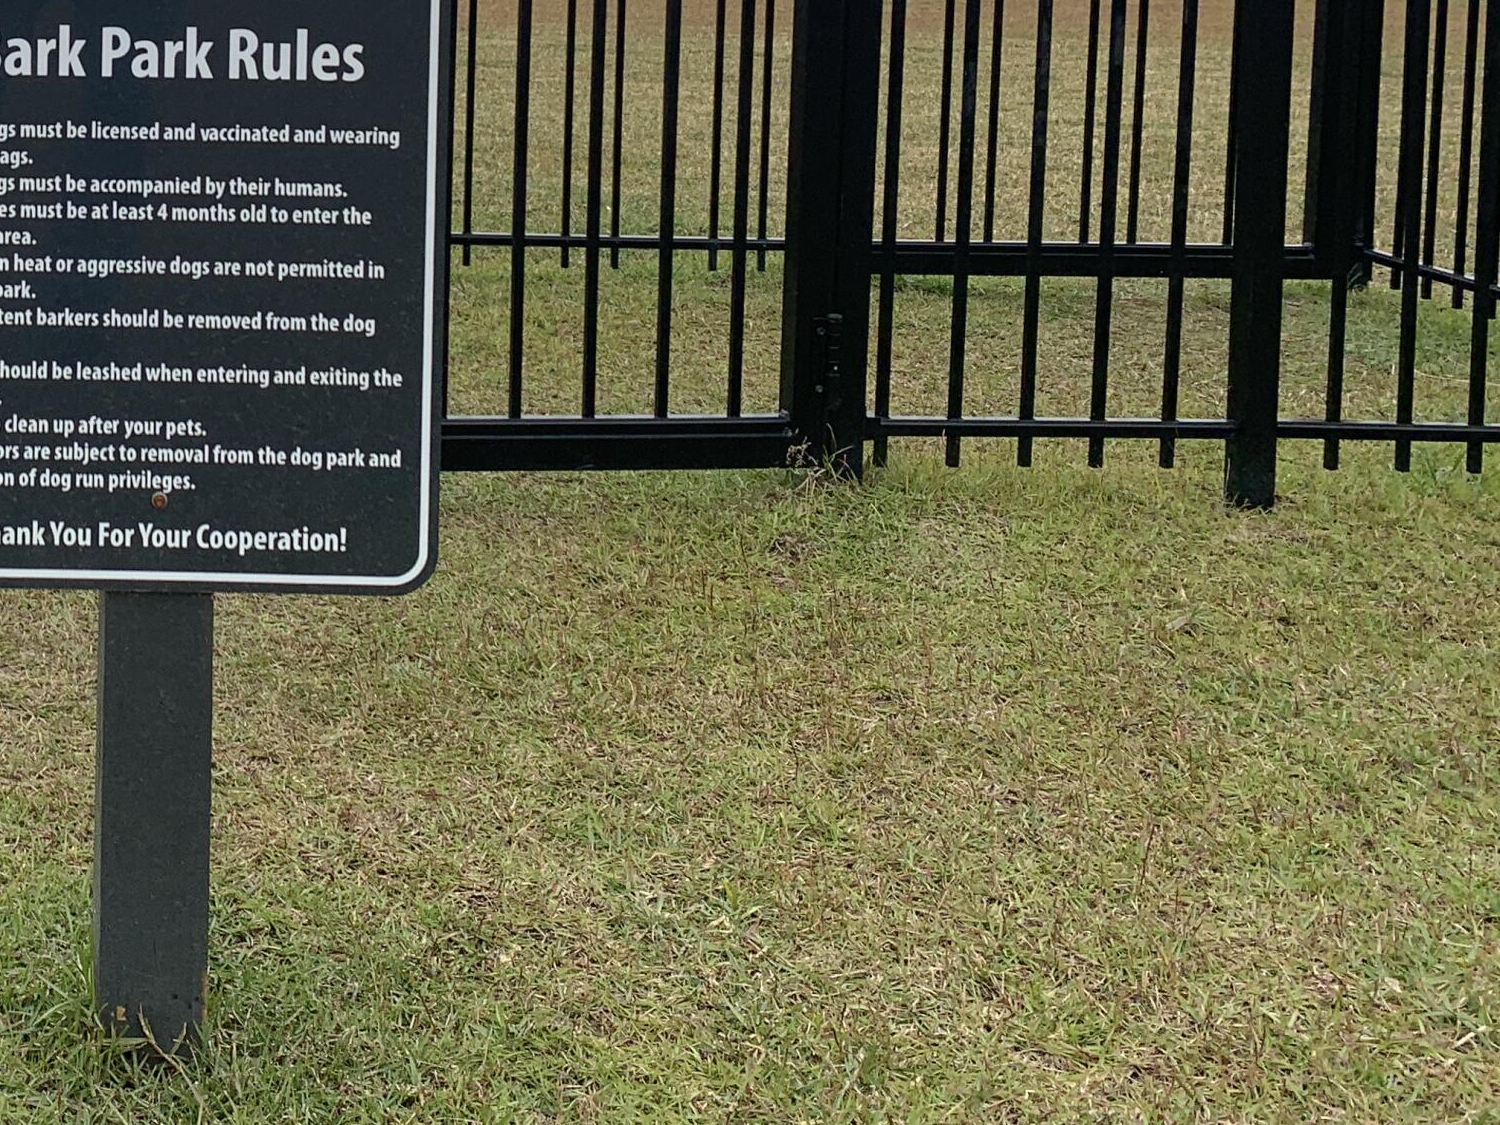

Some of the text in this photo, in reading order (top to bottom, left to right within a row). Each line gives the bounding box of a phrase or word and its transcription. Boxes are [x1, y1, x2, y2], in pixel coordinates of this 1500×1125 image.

[101, 26, 214, 79] Park
[228, 28, 365, 82] Rules
[20, 121, 63, 139] must
[66, 120, 88, 139] be
[91, 120, 160, 140] licensed
[163, 122, 196, 141] and
[200, 123, 290, 143] vaccinated
[293, 124, 326, 143] and
[329, 126, 400, 150] wearing
[19, 175, 62, 192] must
[65, 173, 87, 193] be
[90, 175, 202, 198] accompanied
[205, 176, 226, 200] by
[228, 176, 272, 196] their
[274, 177, 348, 198] humans.
[20, 202, 62, 219] must
[66, 200, 88, 219] be
[91, 203, 109, 220] at
[112, 200, 154, 221] least
[156, 203, 169, 221] 4
[171, 203, 237, 222] months
[239, 203, 265, 223] old
[270, 206, 289, 223] to
[292, 207, 340, 224] enter
[342, 205, 372, 225] the
[13, 252, 53, 273] heat
[55, 258, 74, 273] or
[76, 255, 167, 278] aggressive
[169, 255, 210, 280] dogs
[213, 261, 242, 276] are
[245, 259, 275, 277] not
[277, 258, 365, 282] permitted
[368, 260, 385, 279] in
[36, 306, 100, 327] barkers
[102, 308, 159, 328] should
[163, 309, 184, 329] be
[187, 311, 262, 330] removed
[264, 311, 307, 332] from
[310, 312, 340, 332] the
[342, 313, 376, 338] dog
[51, 360, 73, 380] be
[76, 361, 142, 382] leashed
[145, 362, 193, 383] when
[196, 366, 270, 389] entering
[273, 365, 306, 385] and
[309, 366, 370, 391] exiting
[372, 367, 403, 388] the
[4, 413, 49, 434] clean
[53, 418, 75, 439] up
[78, 415, 120, 435] after
[124, 420, 163, 440] your
[165, 418, 207, 441] pets.
[23, 445, 51, 461] are
[54, 441, 116, 466] subject
[118, 444, 137, 462] to
[140, 444, 210, 464] removal
[212, 444, 254, 464] from
[257, 445, 287, 466] the
[290, 446, 323, 471] dog
[326, 447, 365, 471] park
[368, 448, 402, 468] and
[18, 467, 38, 487] of
[39, 467, 72, 492] dog
[75, 473, 105, 488] run
[108, 469, 196, 494] privileges.
[49, 520, 92, 547] You
[98, 521, 135, 548] For
[138, 522, 192, 549] Your
[196, 523, 347, 556] Cooperation!
